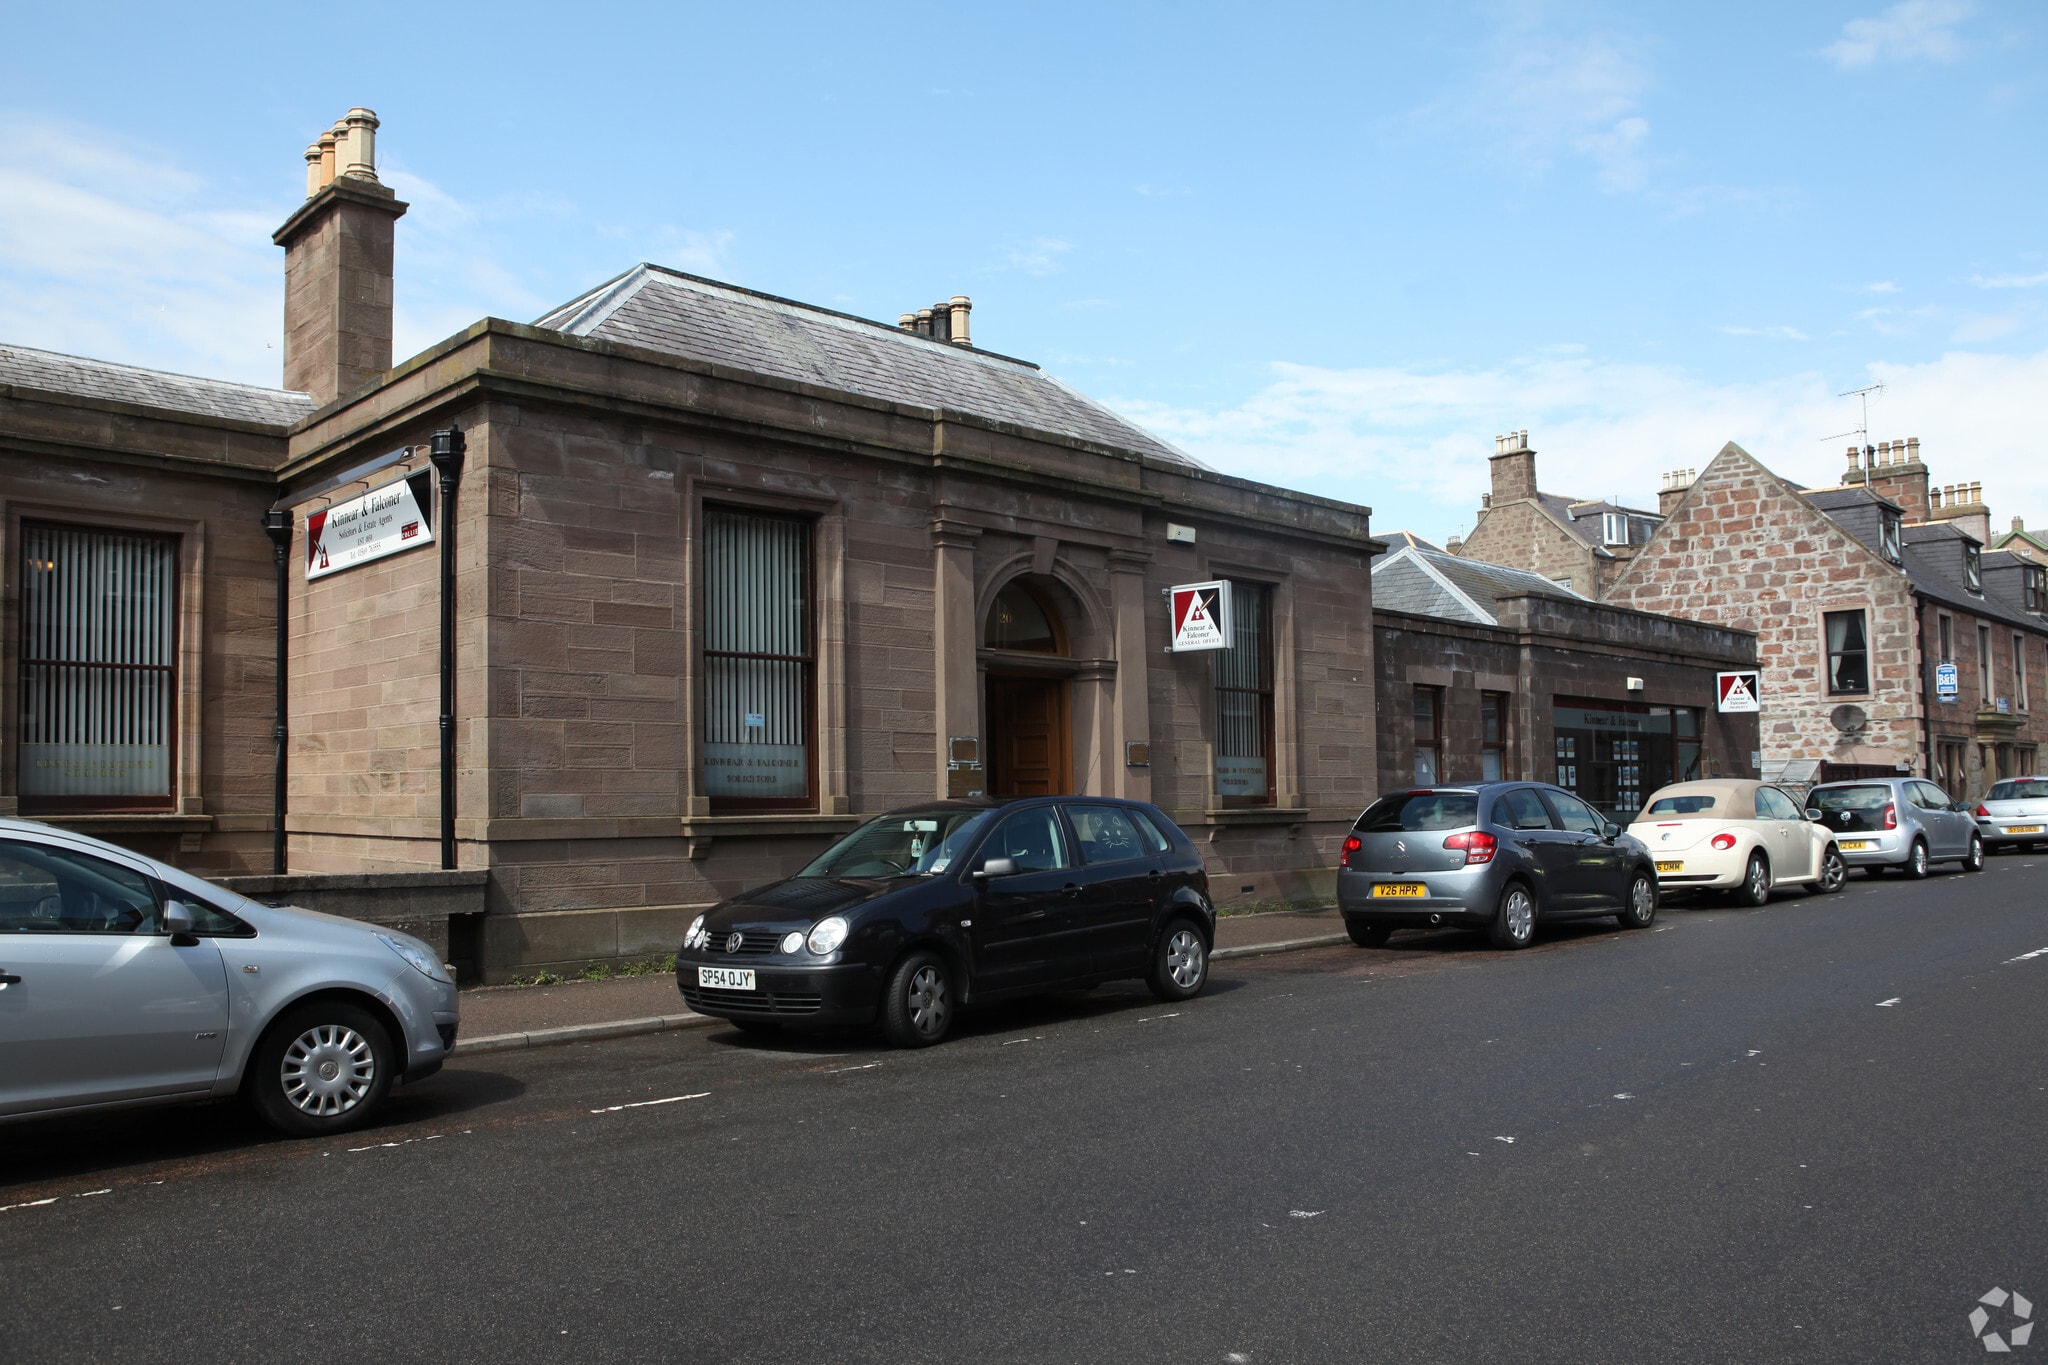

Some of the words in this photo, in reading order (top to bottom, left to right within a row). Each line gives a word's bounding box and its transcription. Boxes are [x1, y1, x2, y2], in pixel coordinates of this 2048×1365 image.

[332, 508, 359, 529] Kinnear
[361, 501, 368, 517] &
[371, 492, 401, 514] Falconer
[339, 526, 358, 540] Solicitors
[358, 524, 363, 534] &
[363, 519, 377, 531] Estate
[379, 514, 393, 528] Agents
[1000, 613, 1012, 624] 20
[1182, 624, 1206, 632] Kinnear
[1187, 631, 1210, 639] Falconer
[1178, 639, 1200, 647] GENERAL
[1938, 674, 1956, 685] B&B
[1610, 715, 1617, 727] &
[704, 757, 744, 767] KINNEAR
[727, 775, 778, 783] SOLICITORS
[1380, 885, 1397, 896] V26
[1399, 885, 1418, 896] HPR
[702, 969, 727, 985] SP54
[729, 971, 750, 987] OJY
